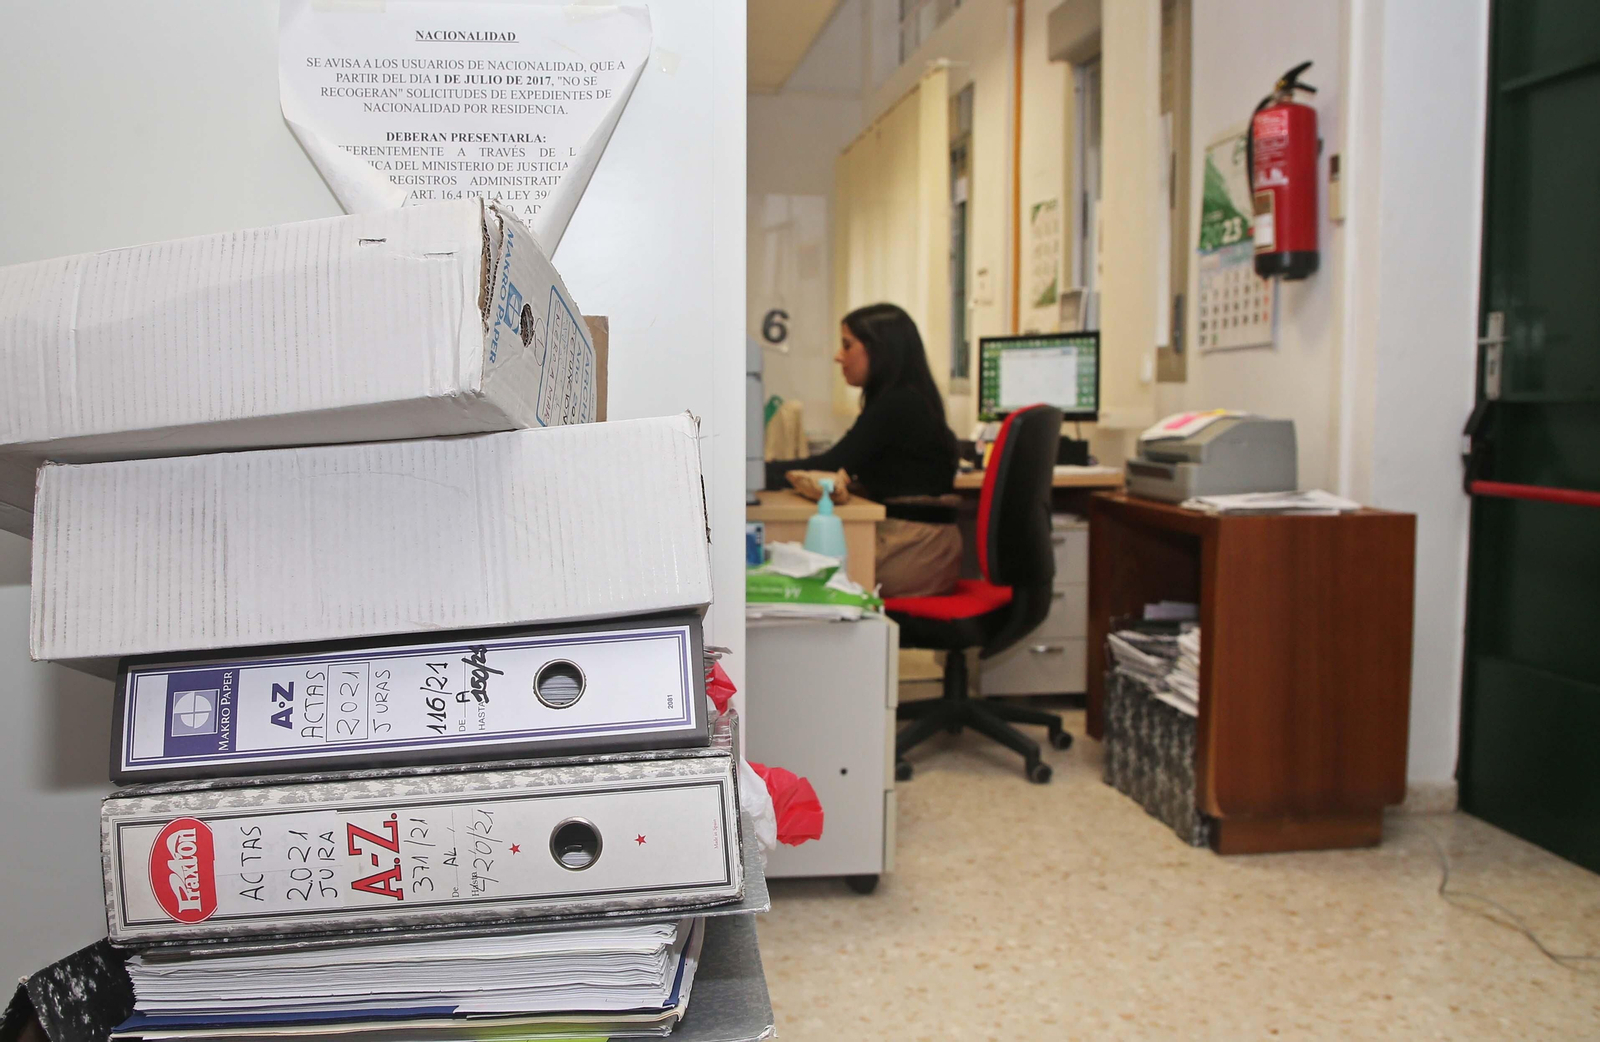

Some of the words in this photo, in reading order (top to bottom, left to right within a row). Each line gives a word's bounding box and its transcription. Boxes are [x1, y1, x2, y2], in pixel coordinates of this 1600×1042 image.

[415, 30, 516, 42] NACIONALIDAD
[306, 57, 322, 68] SE
[324, 58, 361, 68] AVISA
[362, 58, 372, 68] A
[374, 58, 398, 69] LOS
[402, 58, 464, 70] USUARIOS
[468, 60, 484, 70] DE
[487, 60, 587, 73] NACIONALIDAD,
[590, 60, 614, 74] QUE
[616, 60, 626, 70] A
[335, 72, 378, 83] PARTIR
[382, 73, 406, 84] DEL
[409, 74, 432, 84] DIA
[434, 74, 440, 84] 1
[444, 74, 461, 84] DE
[464, 74, 502, 86] JULIO
[506, 75, 523, 86] DE
[526, 76, 554, 87] 2017,
[557, 76, 580, 86] "NO
[583, 76, 598, 86] SE
[320, 86, 404, 98] RECOGERAN"
[406, 88, 487, 99] SOLICITUDES
[490, 90, 507, 100] DE
[510, 90, 592, 100] EXPEDIENTES
[596, 89, 612, 100] DE
[363, 102, 460, 113] NACIONALIDAD
[464, 104, 488, 114] POR
[491, 104, 568, 115] RESIDENCIA.
[386, 132, 447, 142] DEBERAN
[451, 132, 546, 143] PRESENTARLA:
[338, 145, 444, 156] FERENTEMENTE
[457, 147, 466, 157] A
[478, 144, 526, 158] TRAVÉS
[540, 148, 556, 158] DE
[368, 160, 392, 171] ICA
[395, 160, 419, 171] DEL
[422, 160, 494, 172] MINISTERIO
[497, 162, 514, 172] DE
[516, 162, 569, 172] JUSTICIA
[389, 175, 458, 185] REGISTROS
[469, 176, 561, 186] ADMINISTRATI
[410, 190, 436, 200] ART.
[442, 190, 462, 200] 16.4
[487, 190, 502, 200] LA
[507, 190, 531, 200] LEY
[500, 228, 515, 301] MAKRO
[489, 304, 506, 364] PAPER
[762, 308, 790, 344] 6
[220, 670, 233, 706] PAPER
[419, 662, 452, 735] 116/21
[455, 690, 470, 704] A
[300, 669, 326, 738] ACTAS
[336, 671, 360, 736] 2021
[372, 668, 392, 734] JURAS
[666, 693, 674, 710] 2081
[458, 718, 466, 732] DE
[478, 700, 486, 731] HASTA
[218, 706, 232, 752] MAKRO
[238, 825, 265, 902] ACTAS
[318, 830, 338, 899] JURA
[404, 818, 436, 894] 371/21
[442, 846, 459, 867] AL
[166, 828, 202, 914] Praxton
[452, 886, 460, 898] De
[471, 871, 480, 897] Hasta
